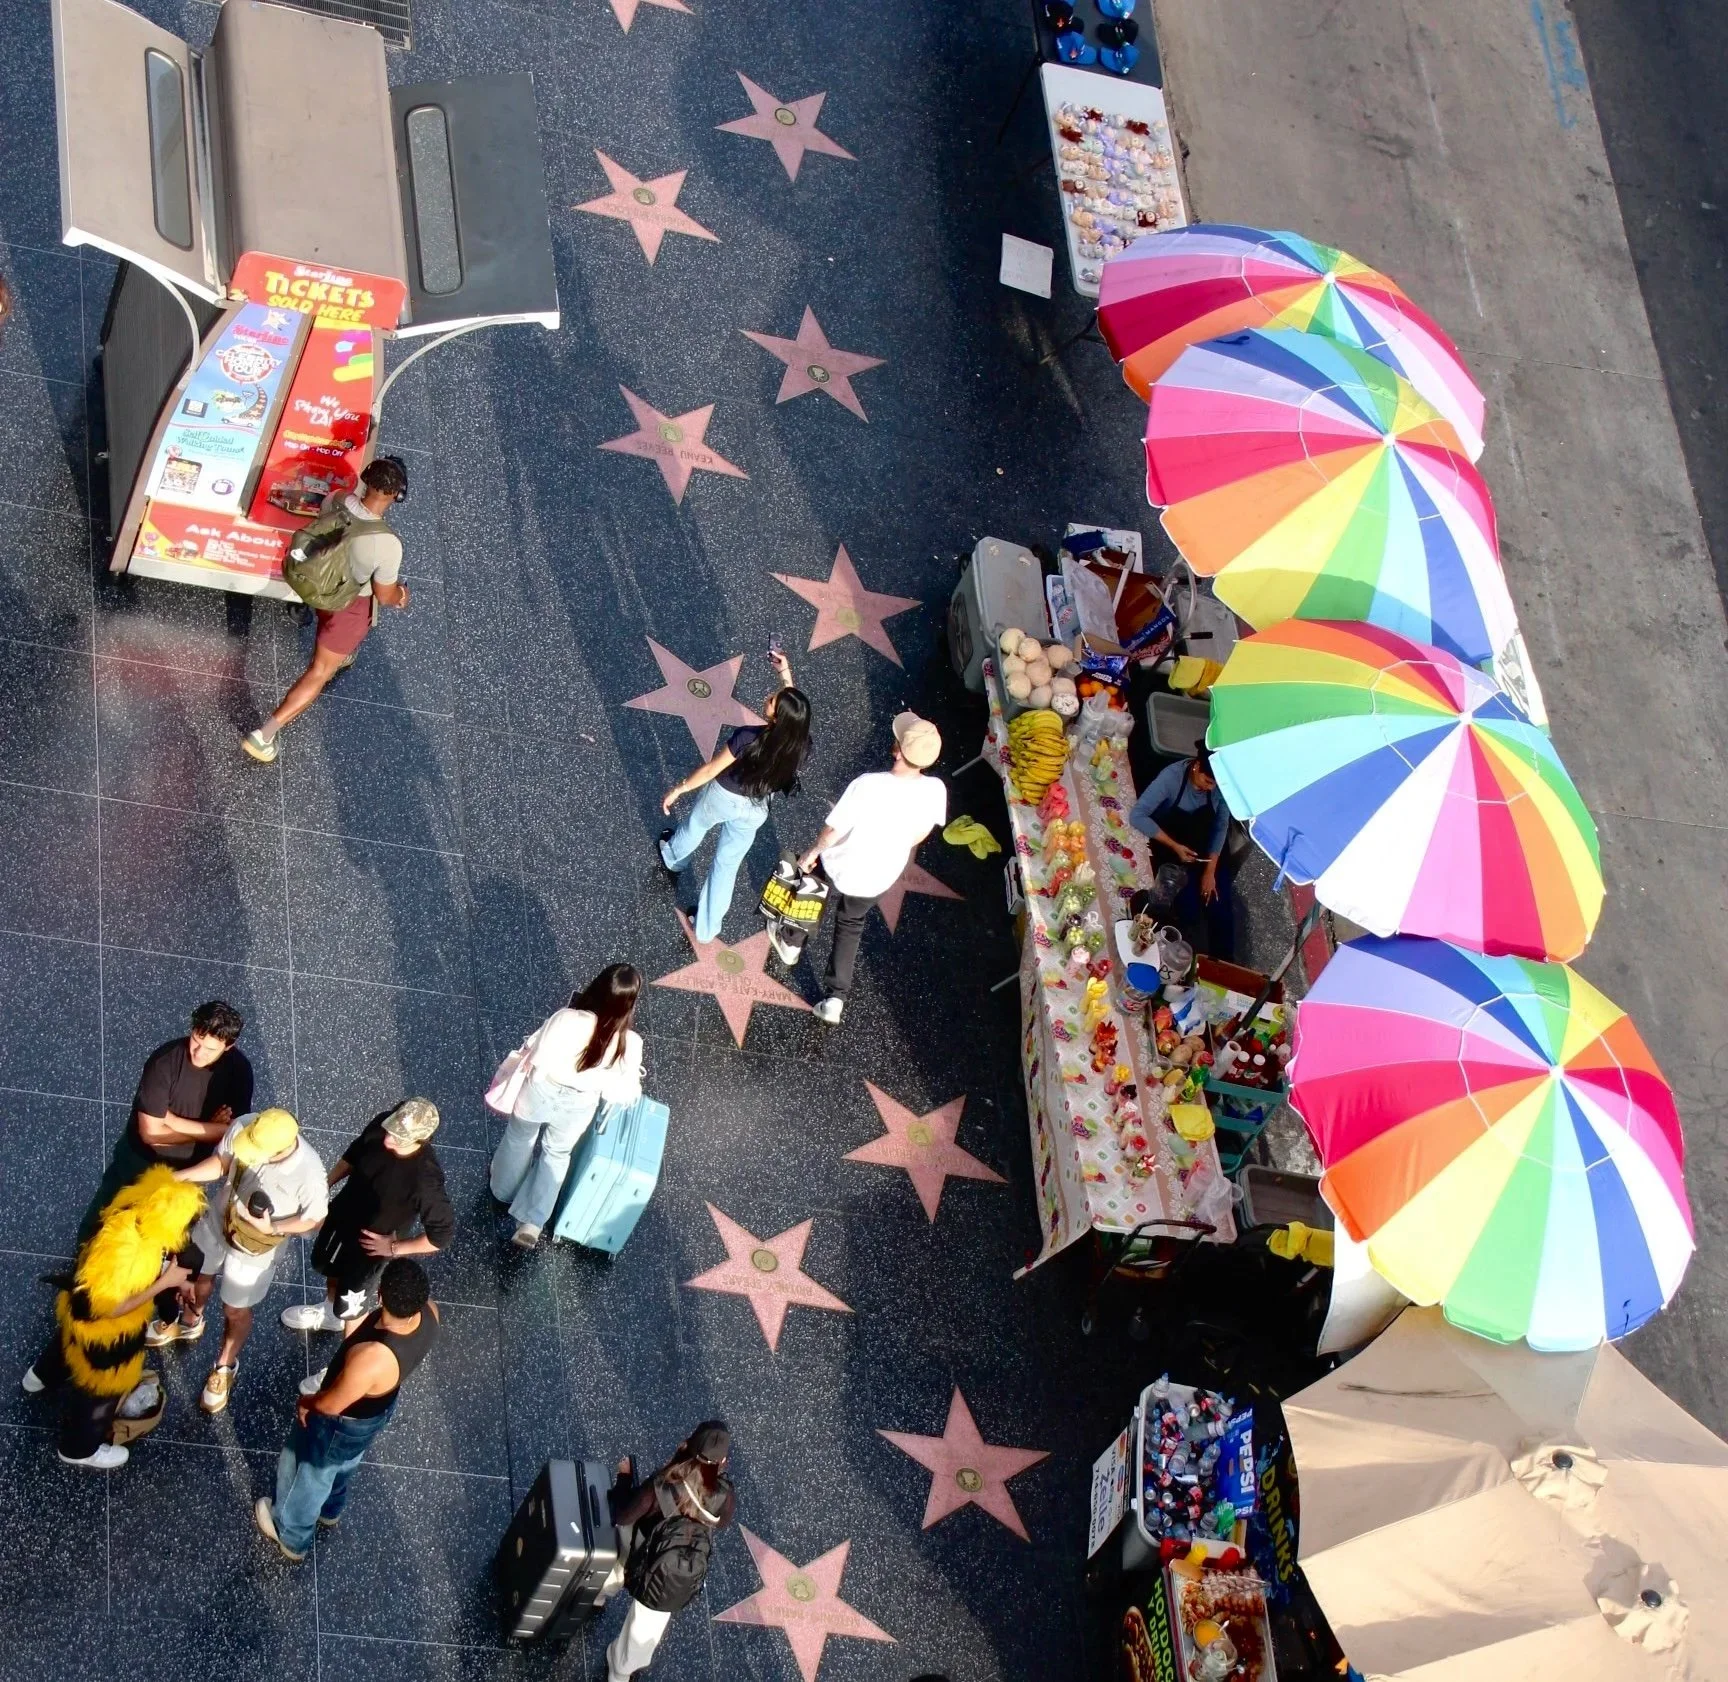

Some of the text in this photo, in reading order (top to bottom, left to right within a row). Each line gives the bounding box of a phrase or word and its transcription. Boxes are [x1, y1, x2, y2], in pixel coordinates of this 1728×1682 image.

[267, 295, 366, 322] SOLD HERE
[334, 408, 360, 421] You
[316, 447, 331, 456] Hop
[332, 449, 344, 457] Off
[637, 441, 713, 465] KEANU REEVES
[185, 524, 284, 548] Ask About
[1145, 616, 1170, 636] MANGOS
[1239, 1428, 1255, 1495] PEPSI
[1262, 1464, 1293, 1582] DRINKS
[1149, 1616, 1165, 1682] DRINK
